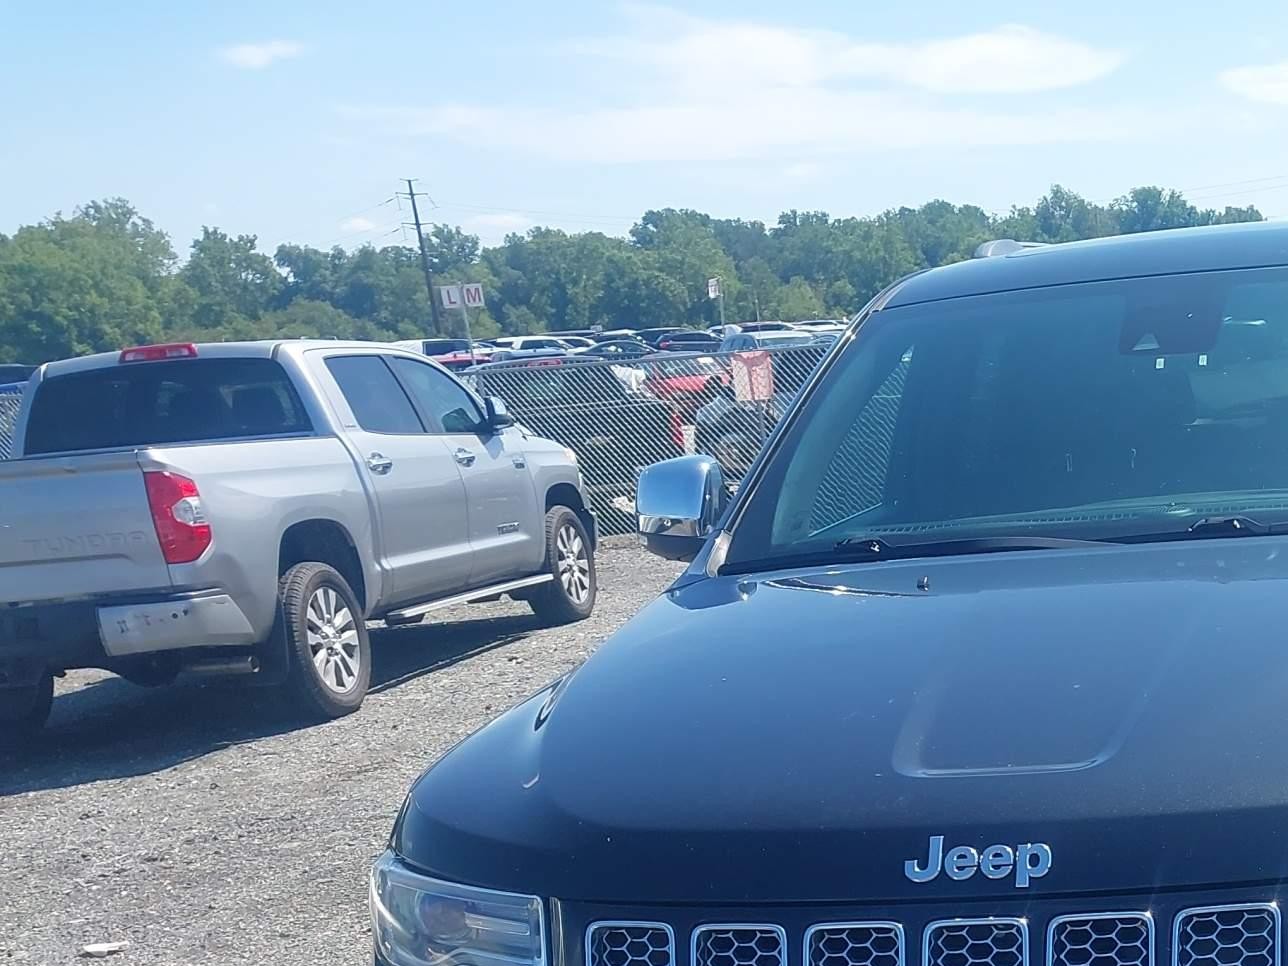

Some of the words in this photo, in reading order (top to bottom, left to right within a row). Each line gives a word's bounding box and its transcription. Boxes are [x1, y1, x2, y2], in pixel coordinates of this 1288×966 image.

[446, 289, 457, 305] L
[465, 287, 482, 304] M
[904, 835, 1052, 888] Jeep
